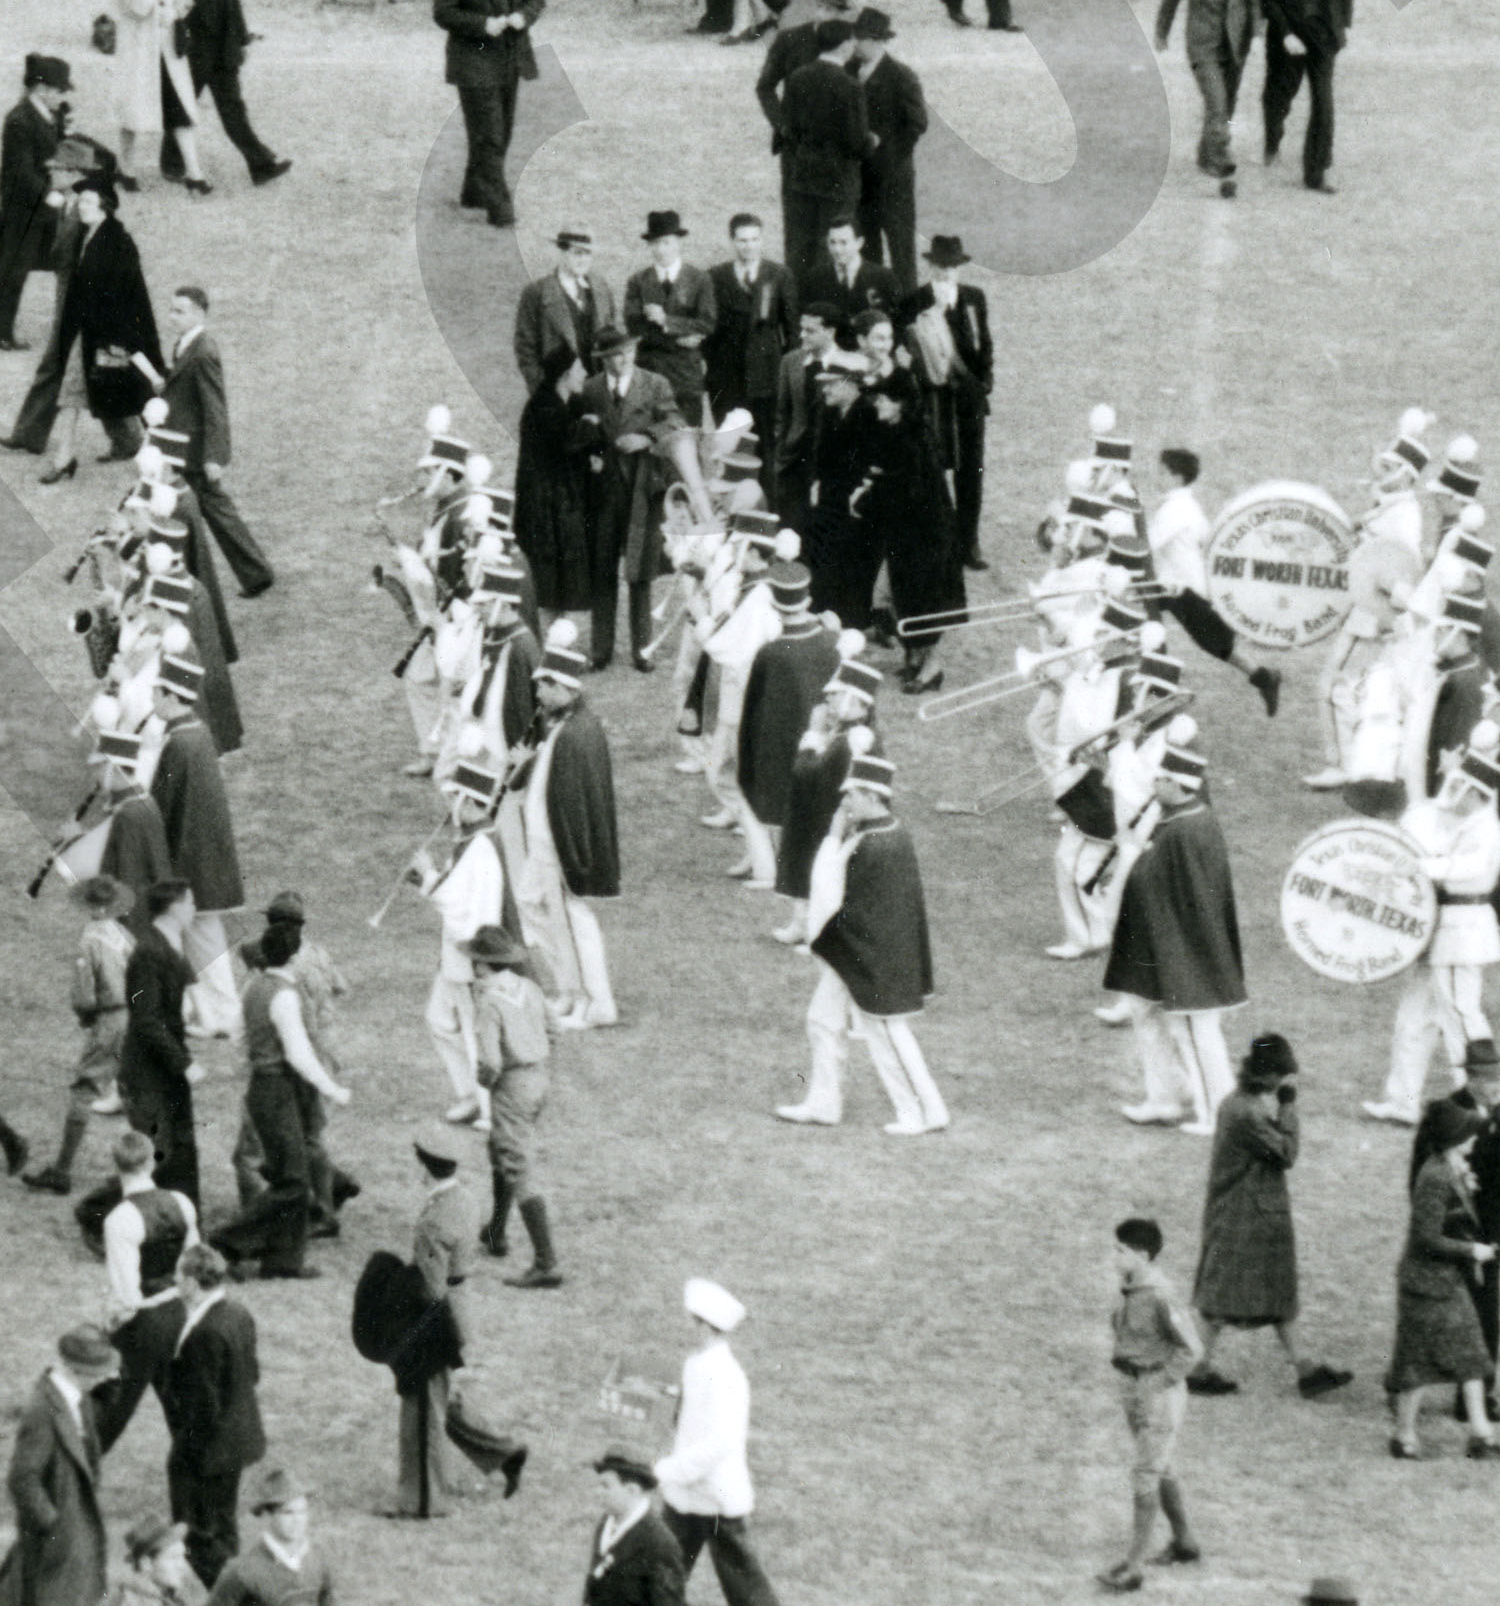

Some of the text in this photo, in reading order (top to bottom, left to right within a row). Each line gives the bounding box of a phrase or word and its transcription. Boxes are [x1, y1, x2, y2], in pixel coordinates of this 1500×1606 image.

[1213, 555, 1350, 591] FORT WORTH TEXAS
[1290, 872, 1328, 901] FORT
[1378, 903, 1427, 939] TEXAS
